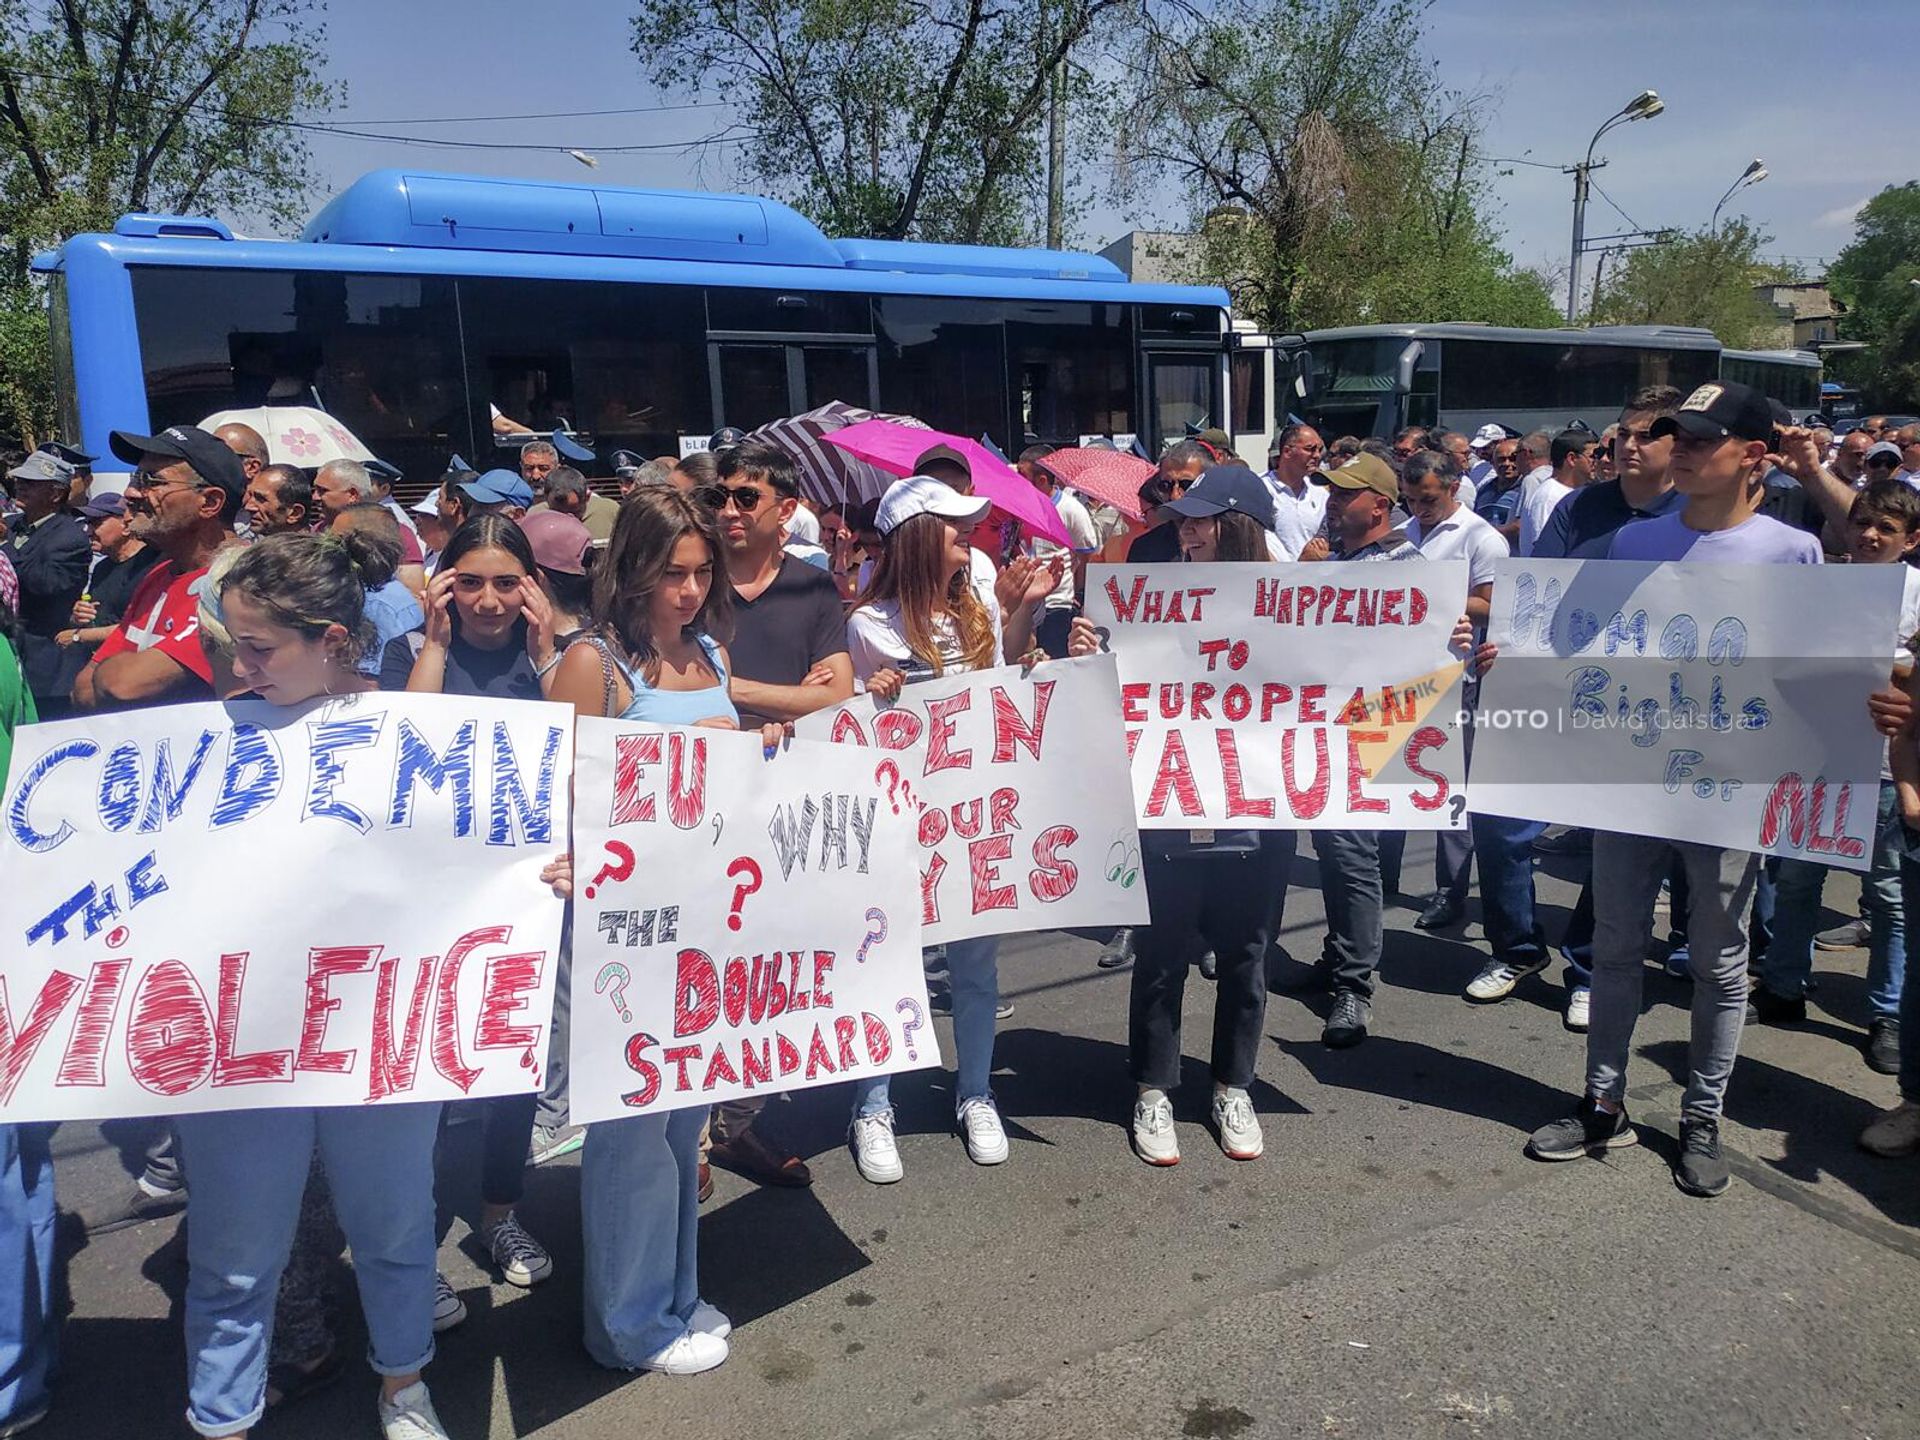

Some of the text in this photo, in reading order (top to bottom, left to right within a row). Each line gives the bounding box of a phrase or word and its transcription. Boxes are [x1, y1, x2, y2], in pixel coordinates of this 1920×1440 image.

[1104, 574, 1429, 628] WHAT HAPPENED
[1198, 638, 1251, 672] TO
[1122, 682, 1417, 727] EUROPEAN
[1566, 665, 1773, 748] Rights
[6, 710, 564, 853] CONDEMN
[919, 787, 1022, 848] OUR
[1759, 771, 1866, 858] ALL
[767, 793, 878, 882] WHY
[920, 824, 1079, 926] YES
[26, 850, 168, 945] THE
[599, 905, 680, 948] THE
[673, 947, 837, 1038] DOUBLE
